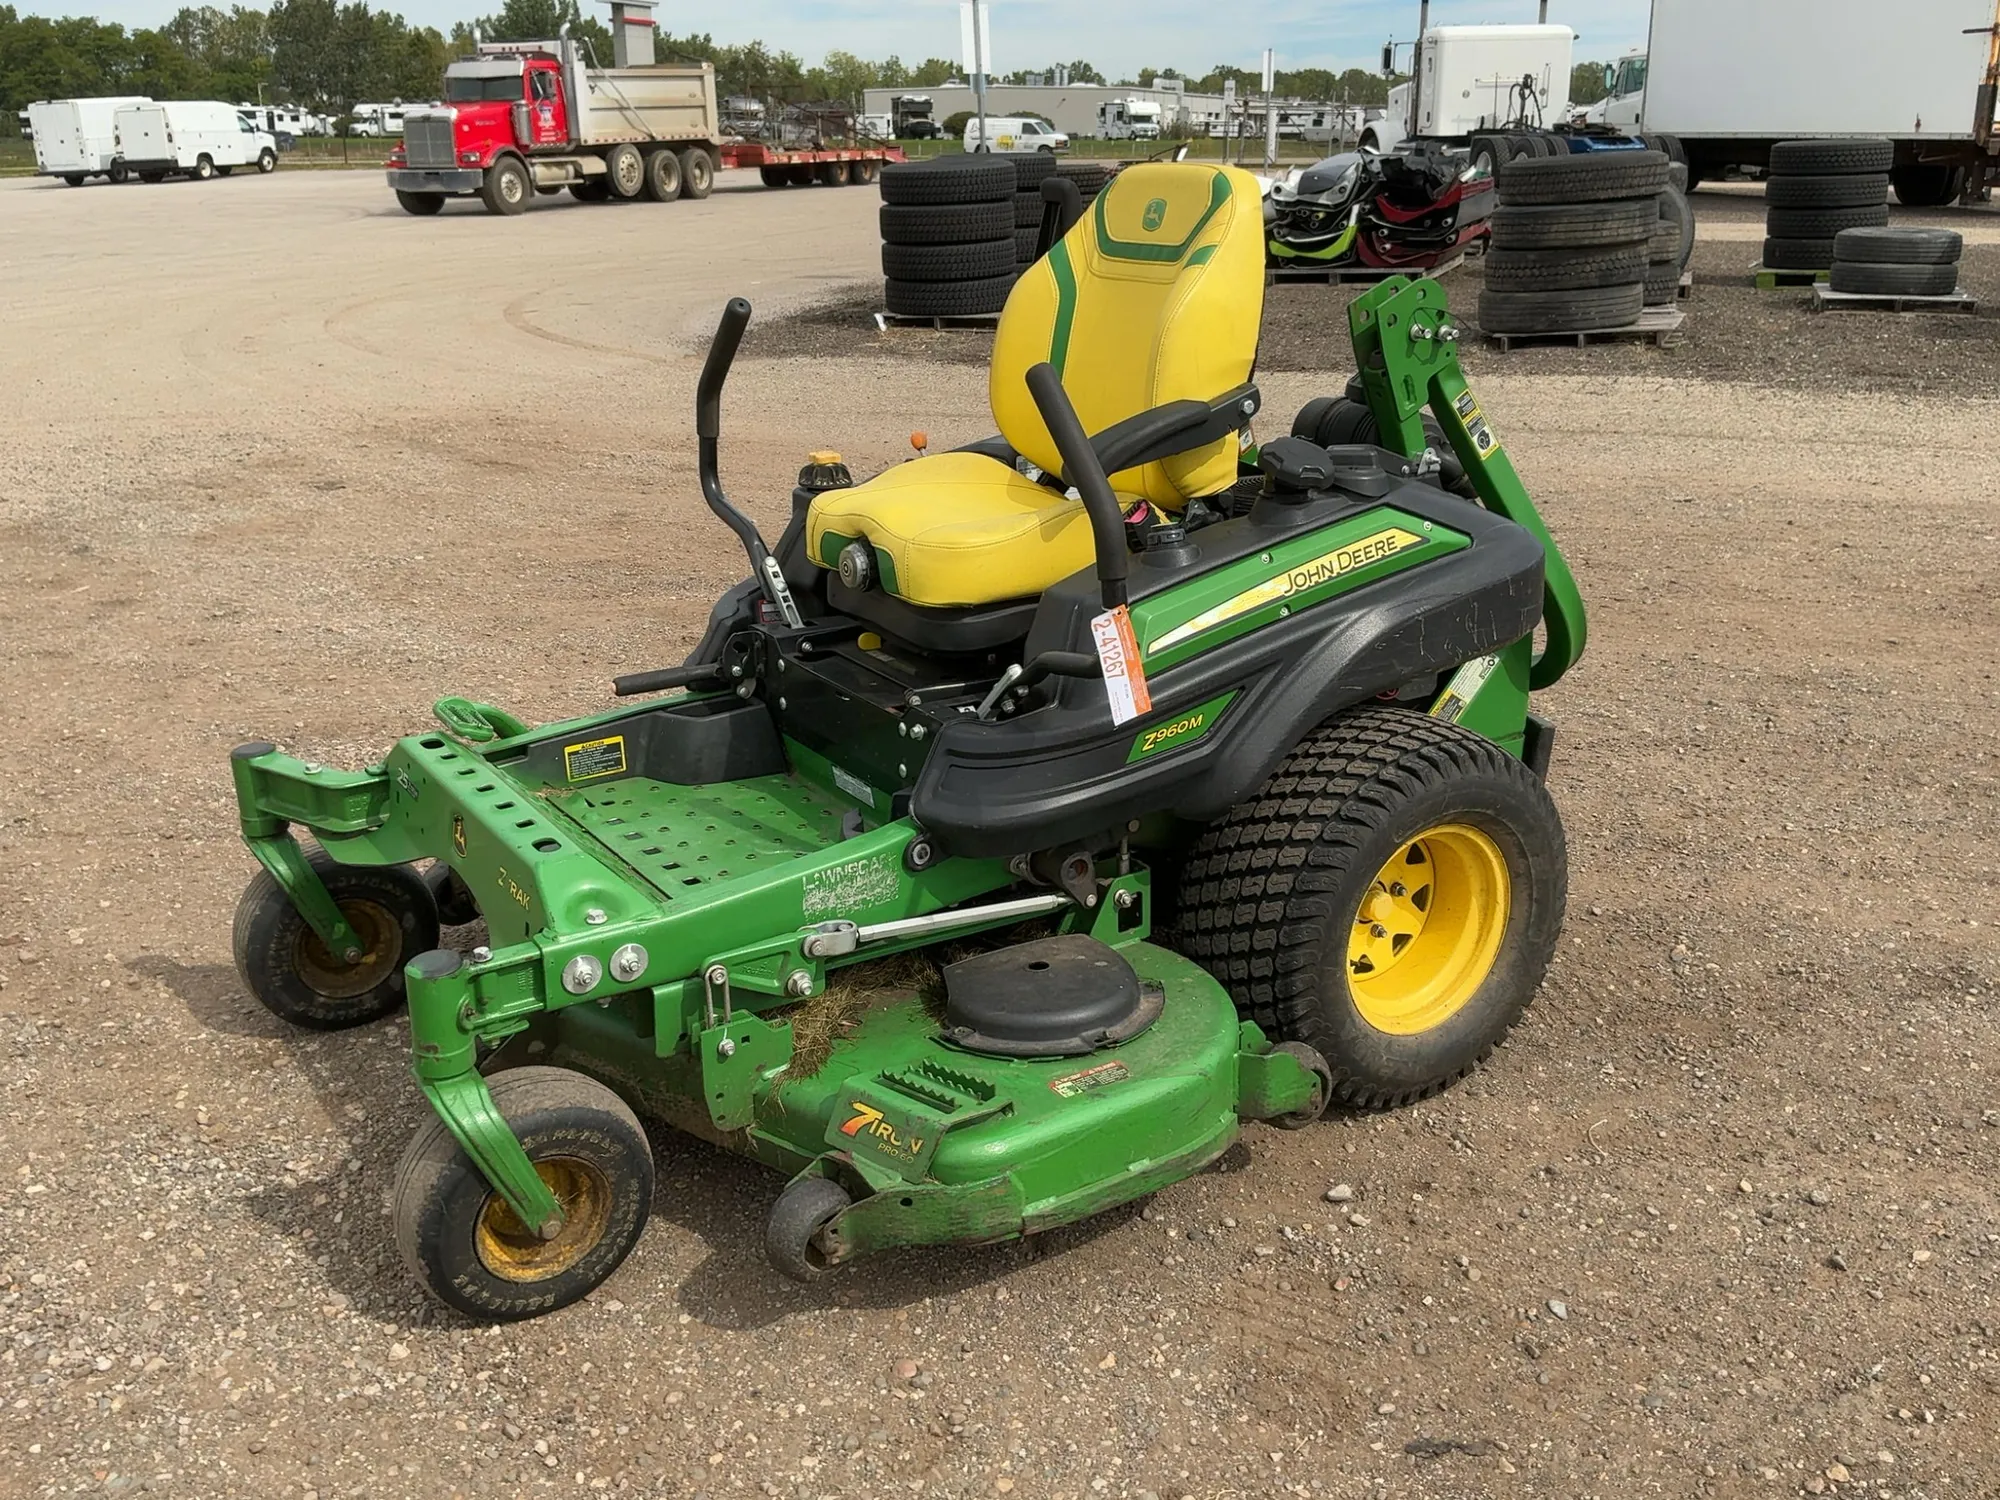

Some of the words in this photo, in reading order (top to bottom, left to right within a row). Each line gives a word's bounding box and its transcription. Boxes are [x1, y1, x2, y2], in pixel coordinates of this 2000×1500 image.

[1284, 561, 1334, 594] JOHN
[1337, 535, 1398, 571] DEERE
[1093, 619, 1126, 679] 2-41267
[1142, 714, 1204, 752] Z960M
[877, 1143, 899, 1157] PRO
